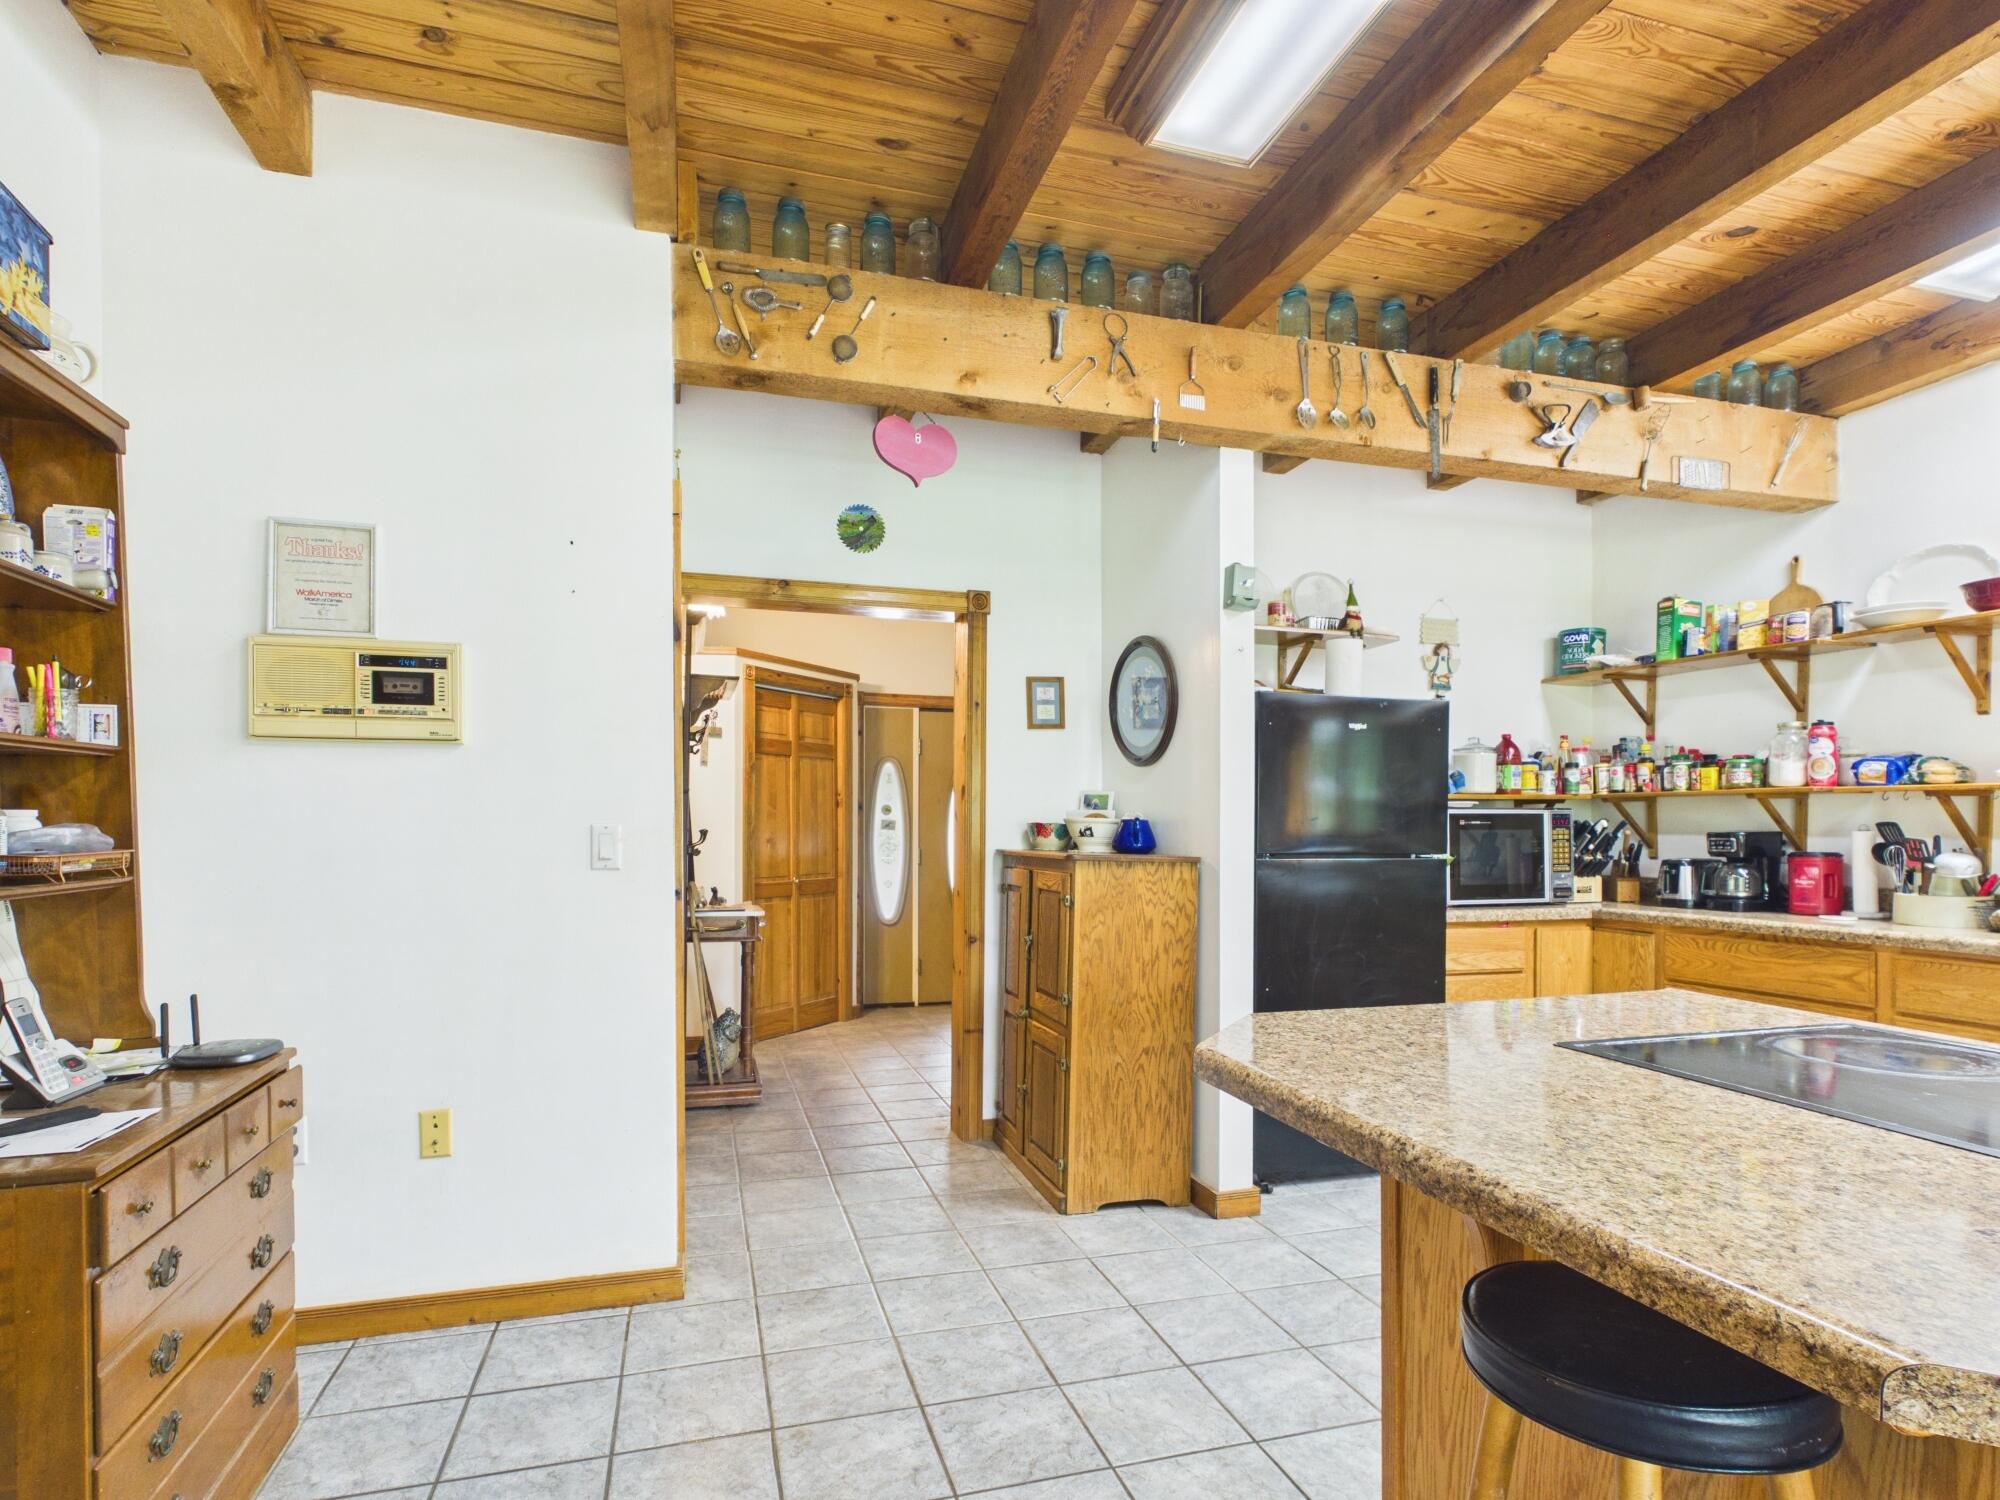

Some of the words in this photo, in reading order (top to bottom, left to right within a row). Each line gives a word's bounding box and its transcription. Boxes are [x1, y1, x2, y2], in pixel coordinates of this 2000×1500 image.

[284, 536, 364, 560] Thanks!
[296, 588, 353, 599] WalkAmerica
[1563, 633, 1589, 643] GOYA
